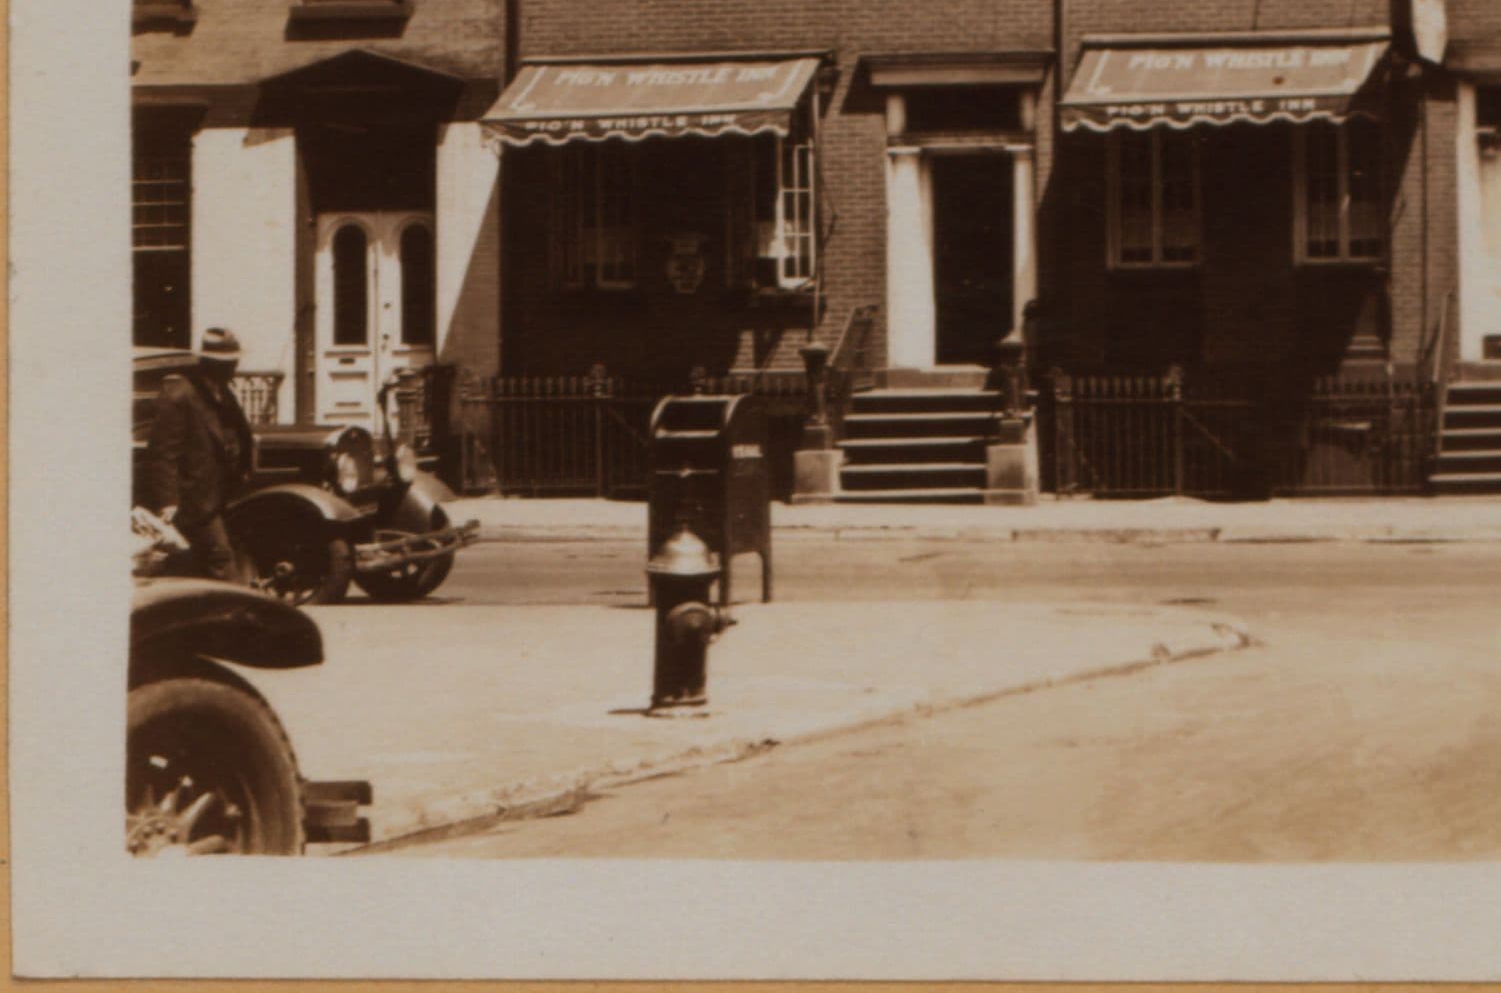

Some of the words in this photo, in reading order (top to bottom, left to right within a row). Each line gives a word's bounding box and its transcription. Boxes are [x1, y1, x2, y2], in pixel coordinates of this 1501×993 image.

[1205, 51, 1307, 69] WHISTLE
[627, 68, 732, 86] WHISTLE
[735, 65, 780, 83] INN
[1176, 100, 1265, 114] WHISTLE
[1279, 98, 1316, 111] INN
[600, 115, 688, 129] WHISTLE
[701, 113, 737, 126] INN
